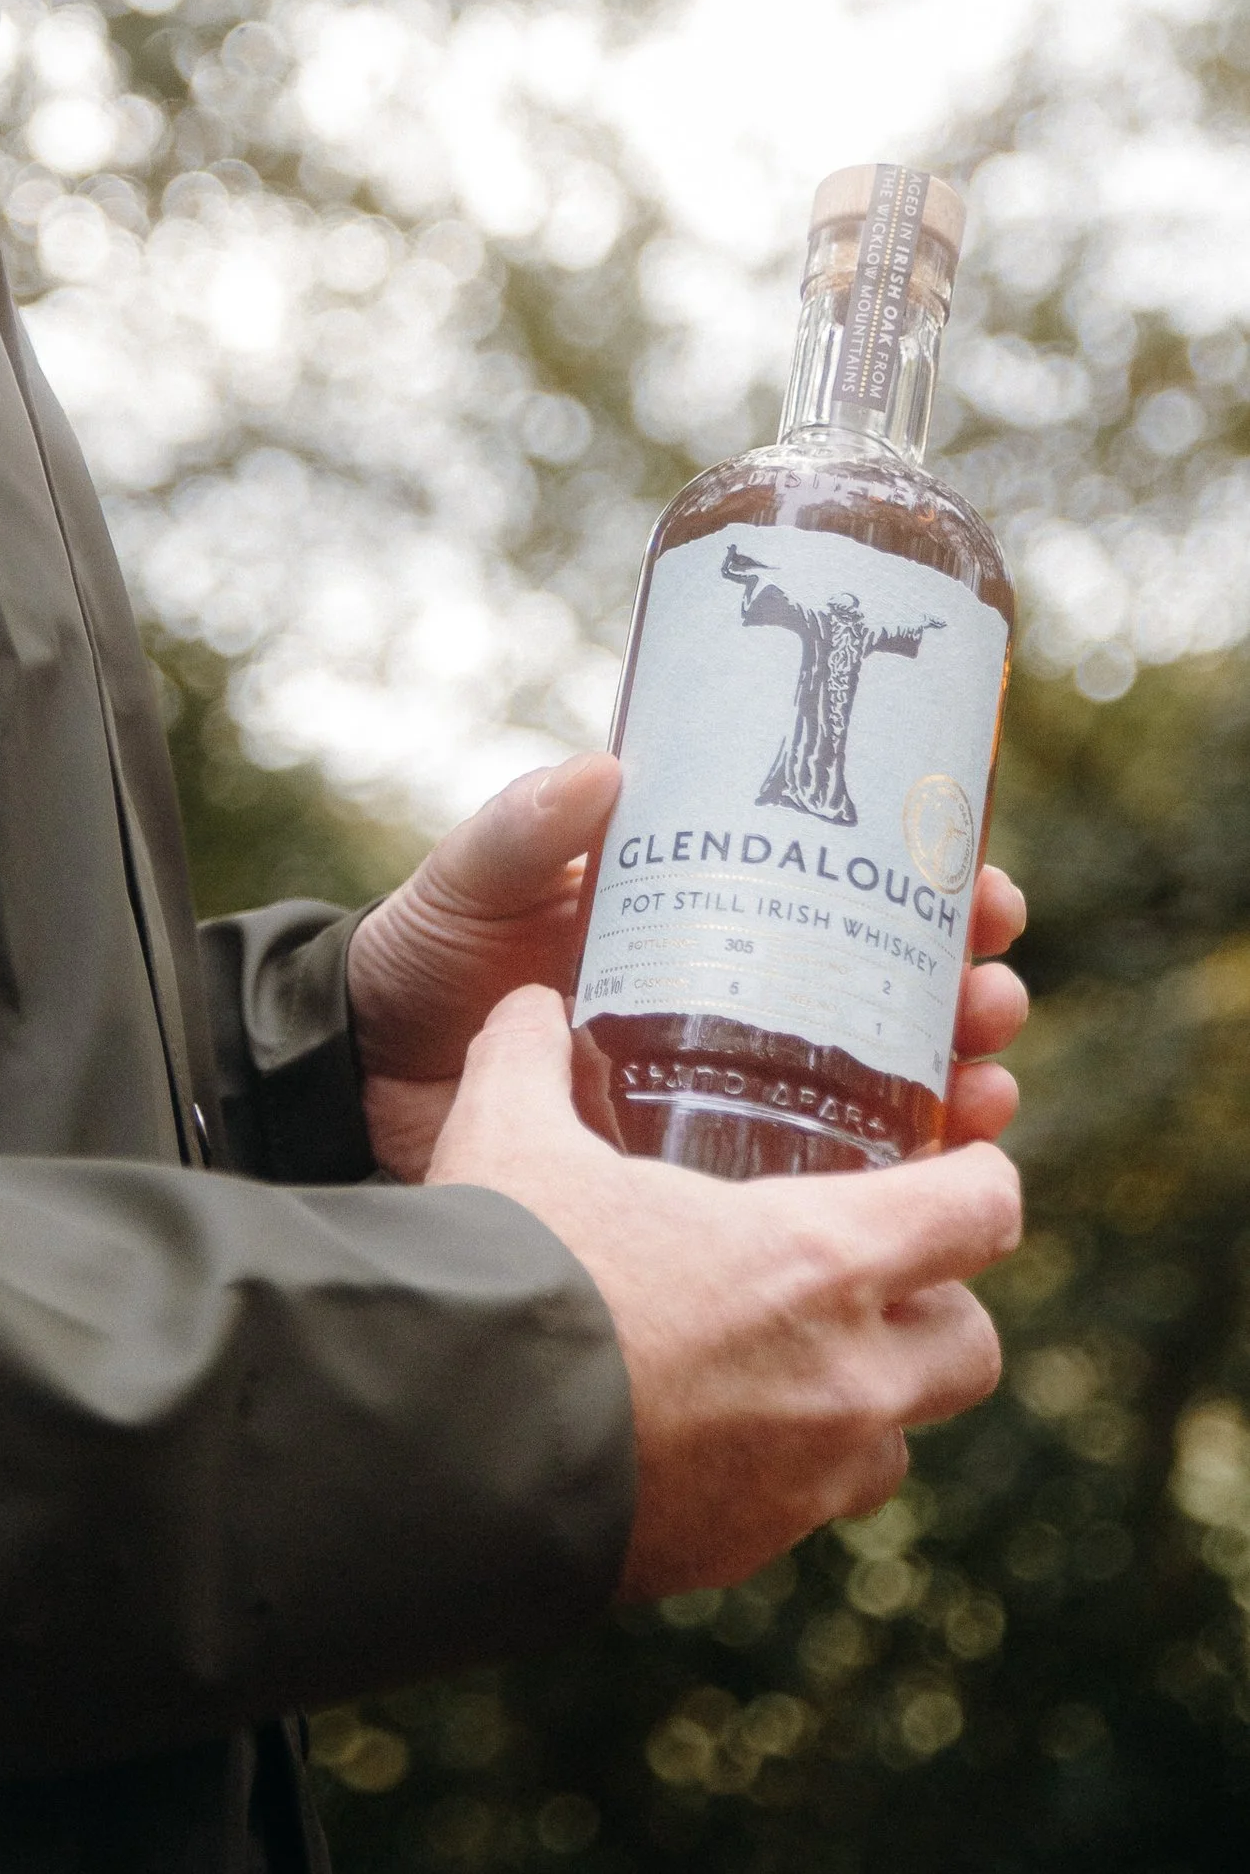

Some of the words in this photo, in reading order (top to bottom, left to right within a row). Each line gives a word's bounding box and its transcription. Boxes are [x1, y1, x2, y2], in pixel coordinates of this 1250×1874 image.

[880, 166, 897, 198] THE
[905, 173, 922, 216] AGED
[864, 204, 890, 280] WICKLOW
[900, 222, 914, 240] IN
[888, 245, 910, 300] IRISH
[878, 305, 898, 347] OAK
[869, 351, 889, 399] FROM
[619, 831, 956, 937] GLENDALOUGH
[621, 892, 665, 915] POT
[673, 891, 745, 913] STILL
[757, 897, 830, 929] IRISH
[843, 916, 938, 976] WHISKEY
[724, 938, 754, 954] 305
[610, 975, 624, 996] Vol
[728, 981, 740, 995] 5
[882, 980, 891, 995] 2
